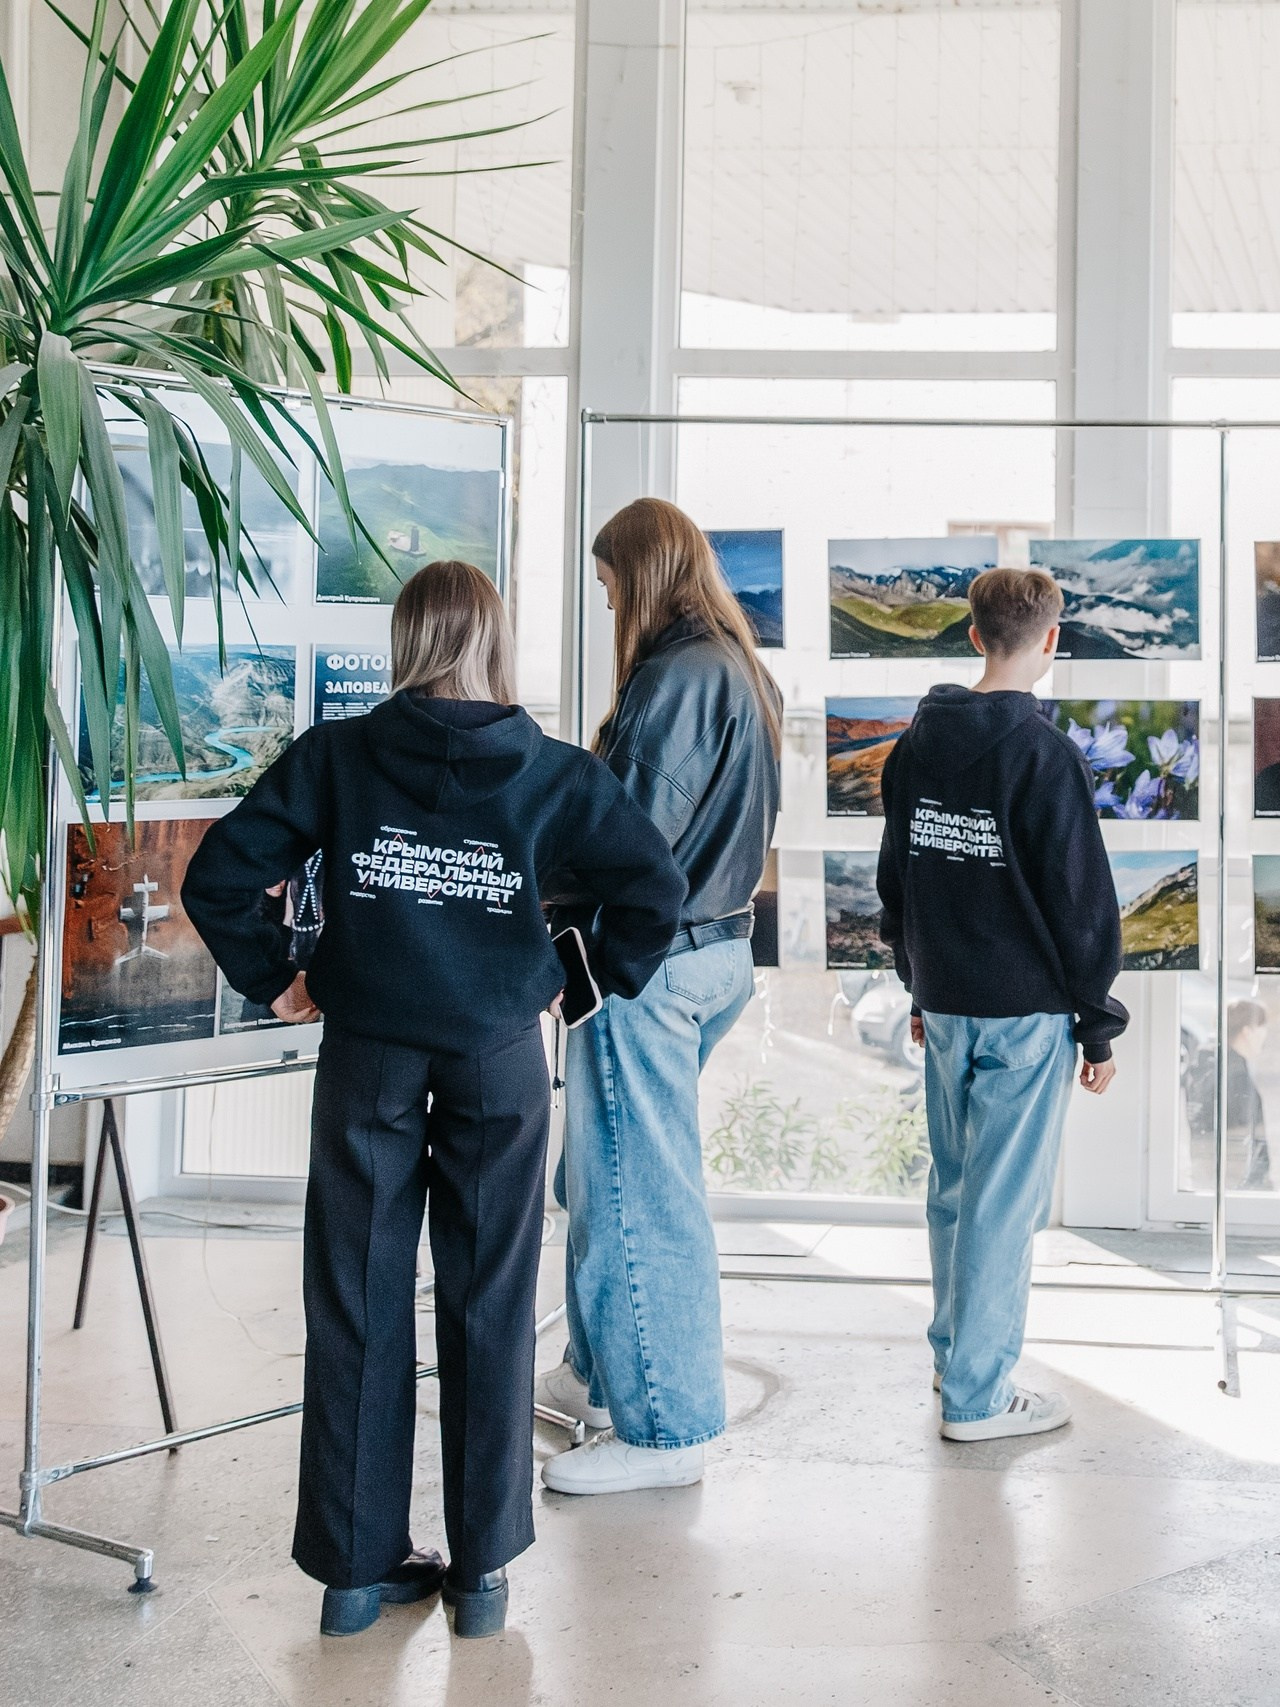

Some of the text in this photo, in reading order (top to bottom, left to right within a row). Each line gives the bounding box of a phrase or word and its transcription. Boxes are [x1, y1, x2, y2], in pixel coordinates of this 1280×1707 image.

[915, 807, 997, 832] КРЫМСКИЙ
[351, 851, 523, 890] ФЕДЕРАЛЬНЫЙ
[373, 838, 504, 871] КРЫМСКИЙ
[356, 868, 515, 904] УНИВЕРСИТЕТ
